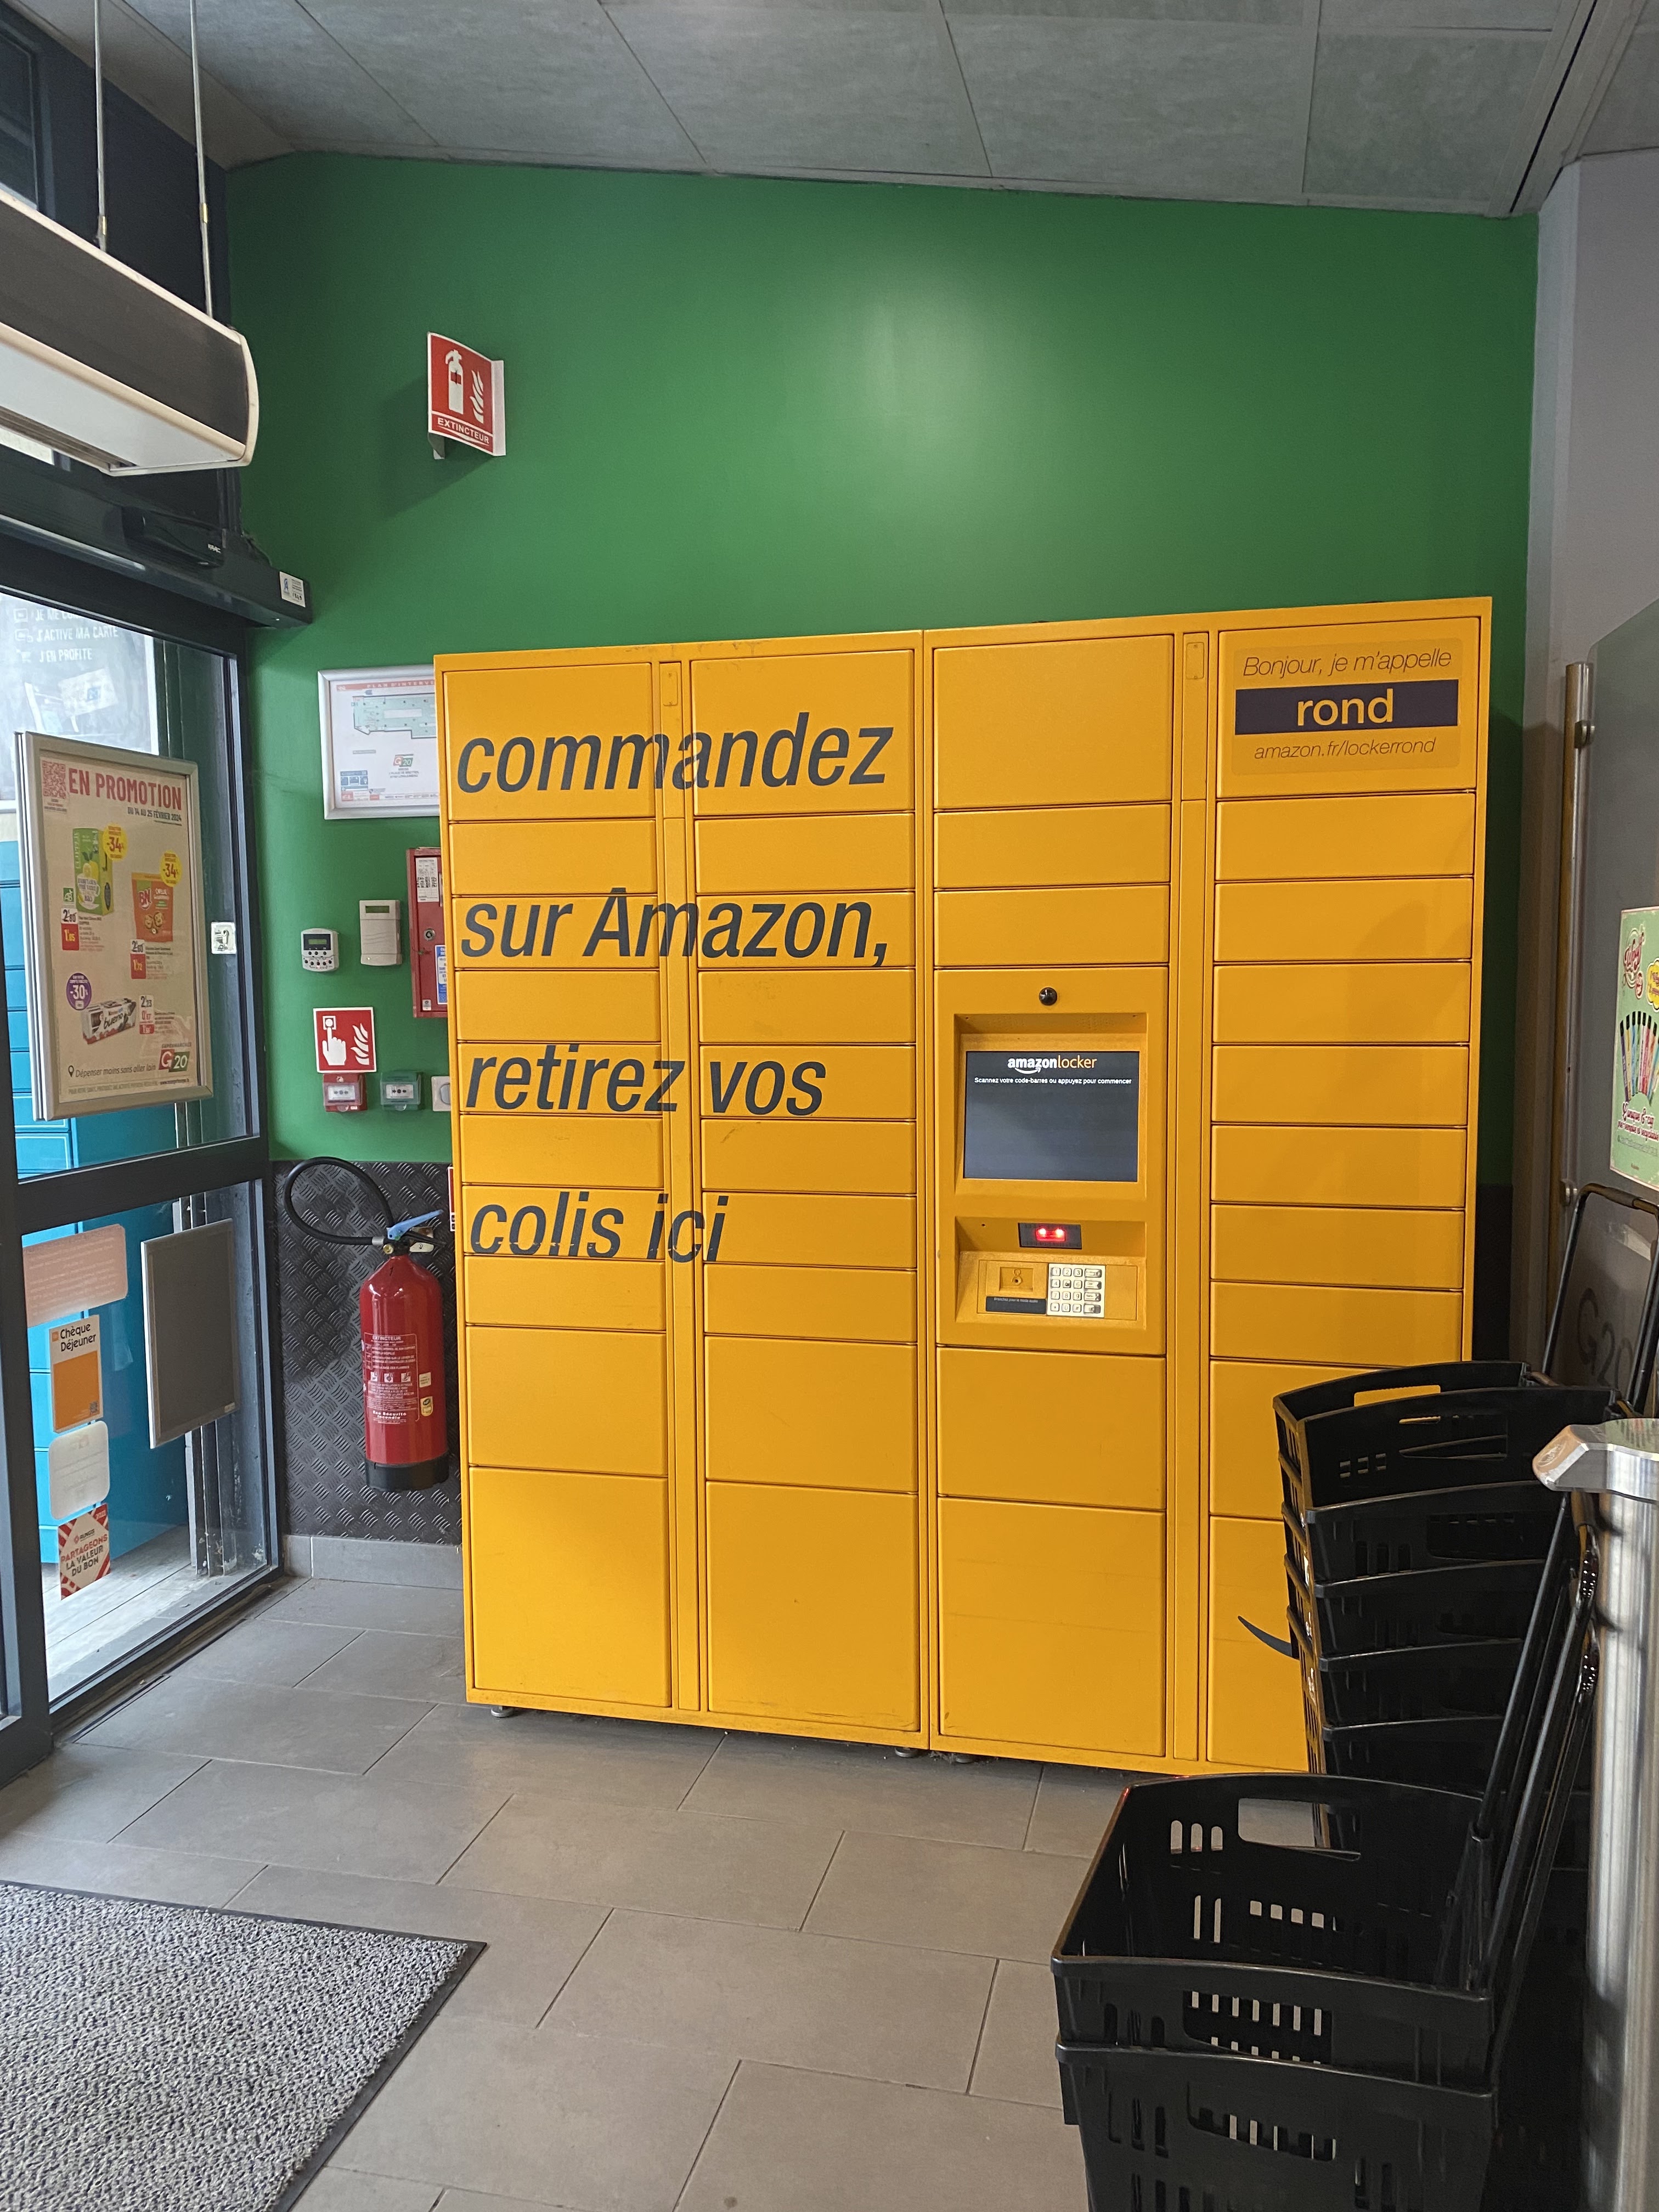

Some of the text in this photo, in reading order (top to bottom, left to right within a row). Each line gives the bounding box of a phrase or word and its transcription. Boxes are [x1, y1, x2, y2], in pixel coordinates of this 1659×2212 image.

[437, 417, 489, 444] EXTINCTEUR
[76, 628, 90, 639] MA
[92, 625, 119, 638] CARTE
[58, 648, 92, 662] PROFITE
[1243, 648, 1452, 679] Bonjour, je m'appelle
[1297, 687, 1394, 727] rond
[458, 712, 894, 794] commandez
[1254, 737, 1437, 759] amazon.fr/lockerrond
[68, 768, 91, 795] EN
[95, 772, 182, 811] PROMOTION
[147, 809, 153, 817] 25
[461, 887, 889, 968] sur Amazon,
[103, 1012, 123, 1029] bueno
[161, 1050, 188, 1069] G20
[1007, 1054, 1098, 1069] amazonlocker
[75, 1069, 102, 1079] Dépenser
[466, 1043, 826, 1116] retirez vos
[470, 1191, 729, 1263] colis ici
[60, 1324, 91, 1339] Chèque
[61, 1334, 97, 1352] Déjeuner
[80, 1529, 95, 1539] RUNGIS
[60, 1534, 108, 1562] PARTAGEONS
[66, 1545, 104, 1570] LA VALEUR
[71, 1556, 99, 1577] DU BON
